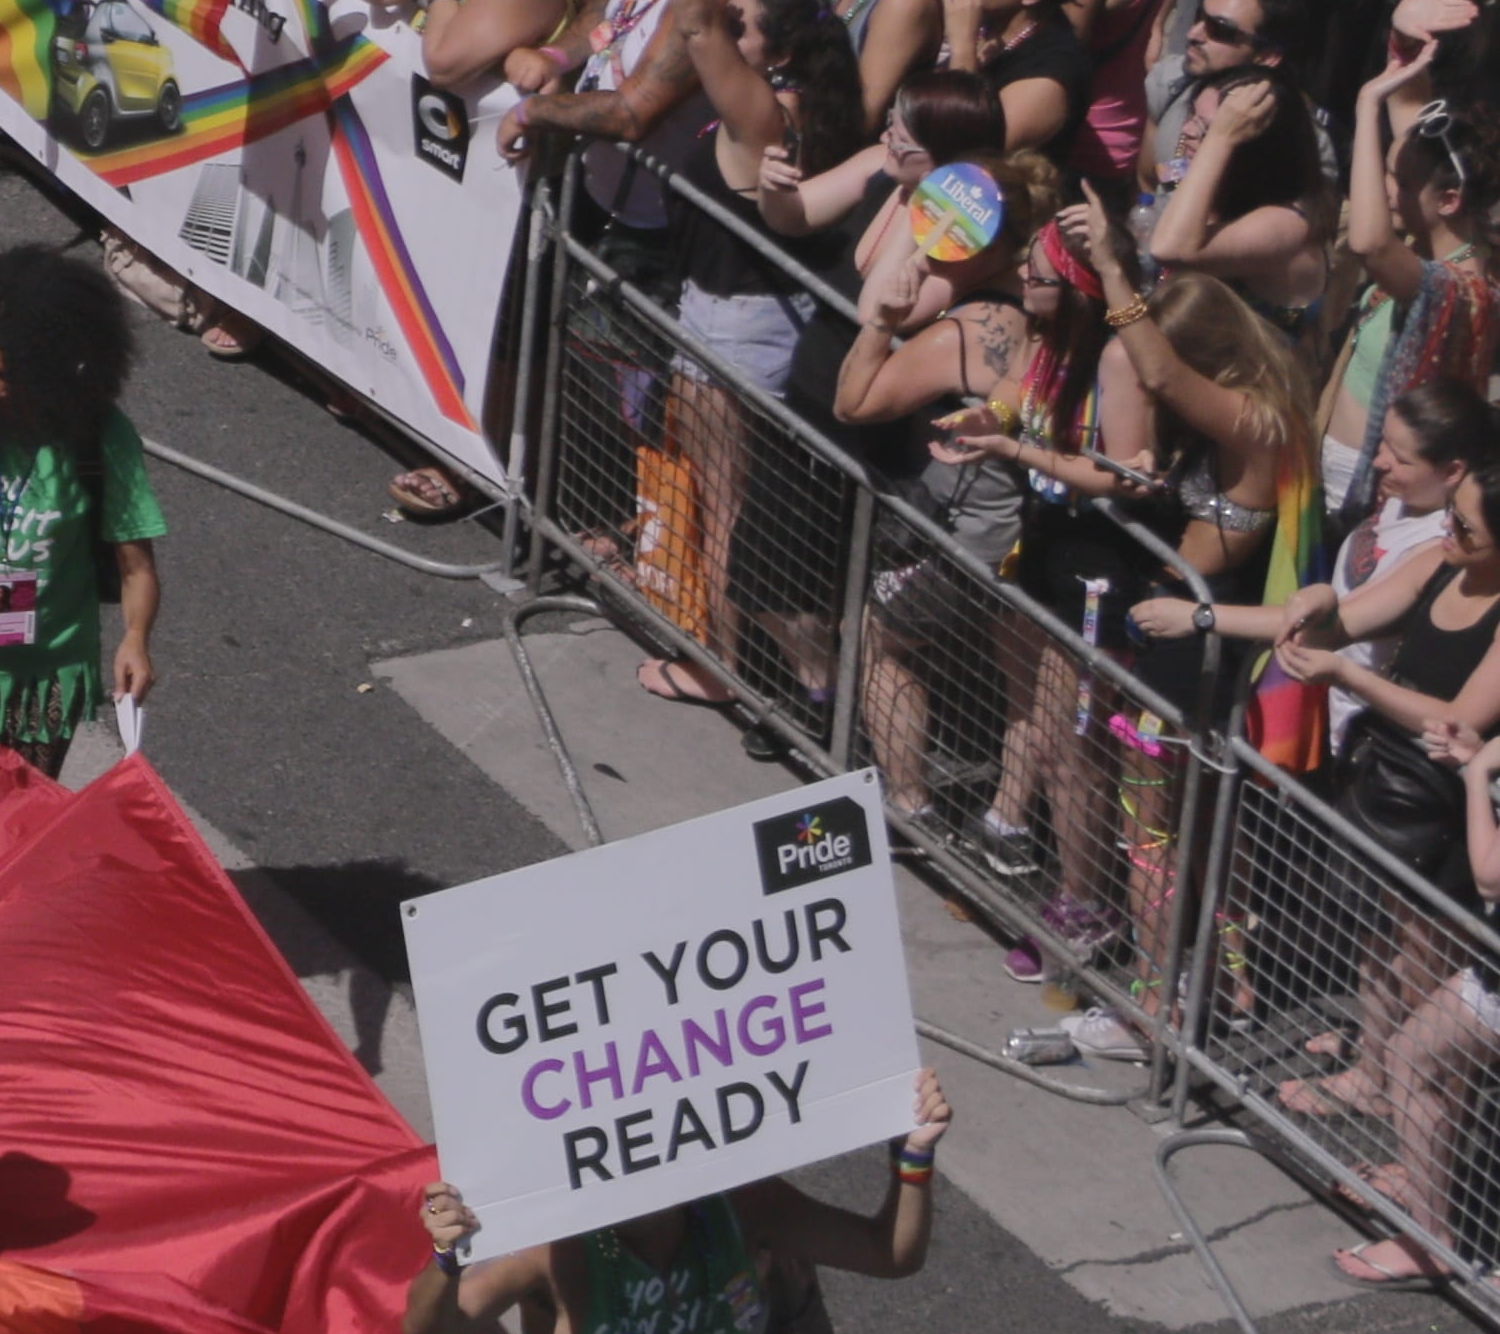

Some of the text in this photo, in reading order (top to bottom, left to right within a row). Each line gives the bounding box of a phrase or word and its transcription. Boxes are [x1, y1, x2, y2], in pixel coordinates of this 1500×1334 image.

[421, 138, 461, 170] smart
[940, 173, 994, 226] Liberal
[777, 831, 851, 875] Pride
[476, 897, 853, 1055] GET YOUR
[521, 978, 833, 1121] CHANGE
[563, 1059, 811, 1191] READY
